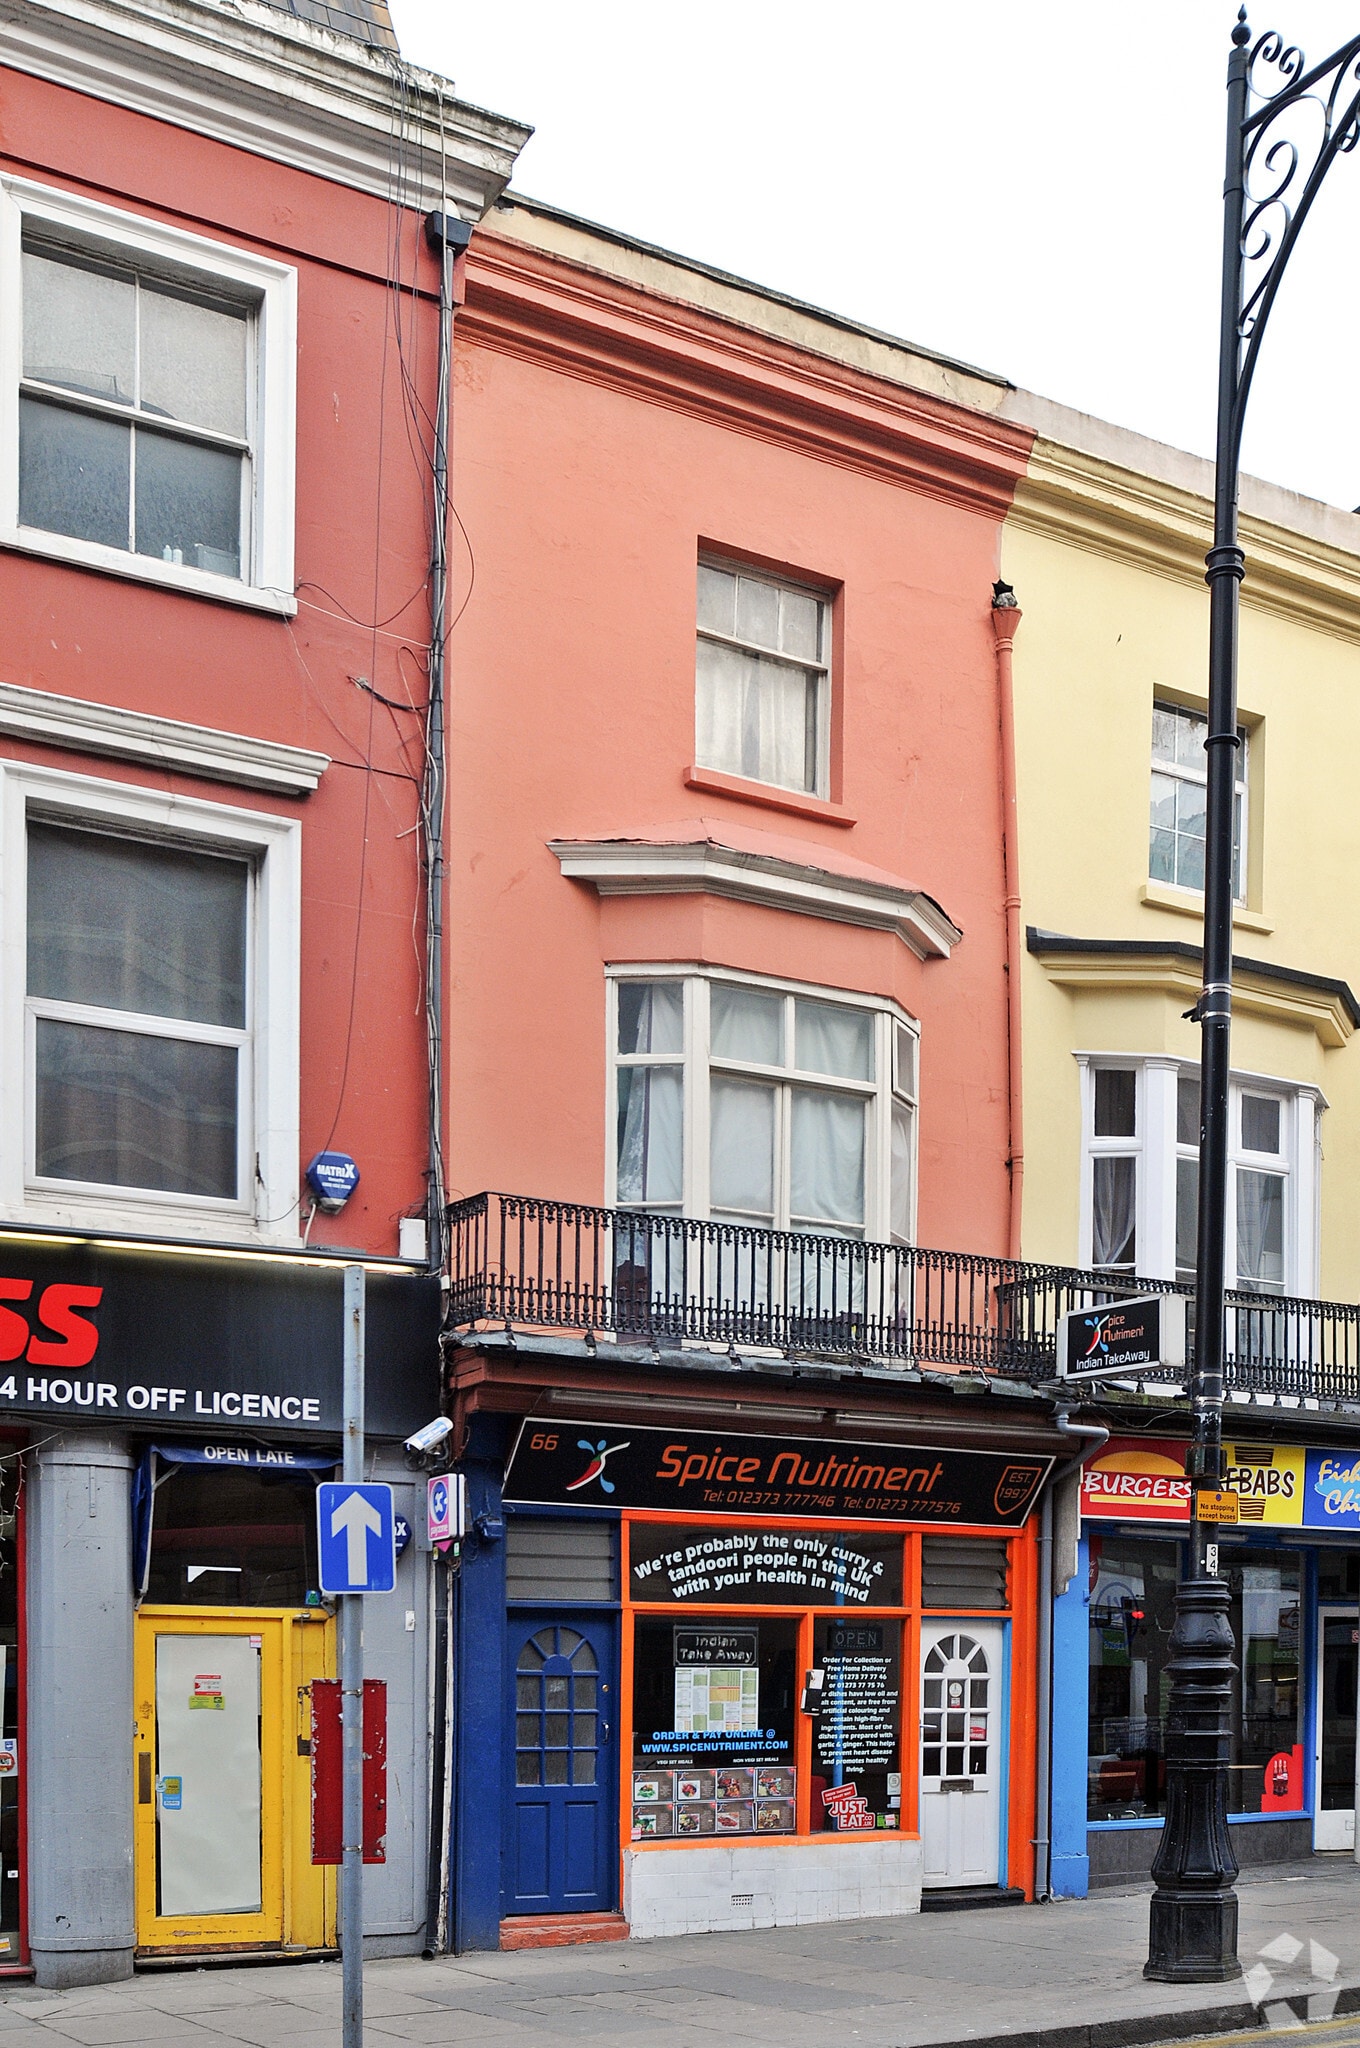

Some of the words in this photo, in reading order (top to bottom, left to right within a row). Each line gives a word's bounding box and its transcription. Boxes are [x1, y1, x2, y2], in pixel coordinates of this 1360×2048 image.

[317, 1164, 355, 1178] MATRIX
[1103, 1325, 1144, 1342] Nutriment
[1076, 1357, 1102, 1370] Indian
[1104, 1350, 1150, 1362] TakeAway
[0, 1376, 17, 1399] 4
[27, 1377, 118, 1407] HOUR
[127, 1386, 187, 1411] OFF
[196, 1391, 320, 1421] LICENCE
[530, 1433, 559, 1451] 66
[204, 1445, 250, 1462] OPEN
[255, 1449, 296, 1464] LATE
[656, 1445, 761, 1487] Spice
[767, 1452, 943, 1493] Nutriment
[1009, 1472, 1032, 1484] EST.
[1219, 1467, 1295, 1498] EBABS
[1000, 1487, 1028, 1499] 1997
[703, 1489, 724, 1502] Tel:
[727, 1490, 779, 1505] 012373
[784, 1493, 836, 1507] 777746
[843, 1496, 863, 1509] Tel:
[865, 1498, 907, 1511] 01273
[910, 1500, 962, 1514] 777576
[1210, 1503, 1235, 1512] stopping
[1198, 1512, 1218, 1521] except
[1219, 1512, 1236, 1520] buses
[633, 1551, 682, 1580] We're
[686, 1536, 758, 1562] probably
[762, 1535, 789, 1548] the
[794, 1539, 828, 1557] only
[831, 1545, 871, 1570] curry
[872, 1561, 885, 1576] &
[667, 1553, 738, 1582] tandoori
[743, 1552, 798, 1569] people
[802, 1554, 818, 1569] in
[821, 1558, 847, 1577] the
[851, 1566, 874, 1587] UK
[672, 1577, 710, 1599] with
[714, 1571, 751, 1591] your
[756, 1569, 807, 1585] health
[811, 1572, 827, 1588] in
[830, 1579, 870, 1602] mind
[695, 1636, 737, 1647] Indian
[835, 1632, 877, 1646] OPEN
[680, 1648, 711, 1660] Take
[716, 1649, 753, 1663] Away
[861, 1665, 886, 1673] Delivery
[848, 1707, 877, 1715] colouring
[854, 1715, 884, 1723] high-fibre
[652, 1731, 690, 1740] ORDER
[691, 1731, 700, 1740] &
[702, 1730, 722, 1739] PAY
[725, 1729, 764, 1739] ONLINE
[765, 1728, 776, 1739] @
[850, 1732, 878, 1740] prepared
[641, 1741, 788, 1753] WWW.SPICENUTRIMENT.COM
[842, 1741, 864, 1749] ginger.
[835, 1758, 865, 1766] promotes
[865, 1757, 889, 1765] healthy
[845, 1766, 865, 1774] living.
[831, 1800, 865, 1814] JUST
[840, 1814, 864, 1827] EAT
